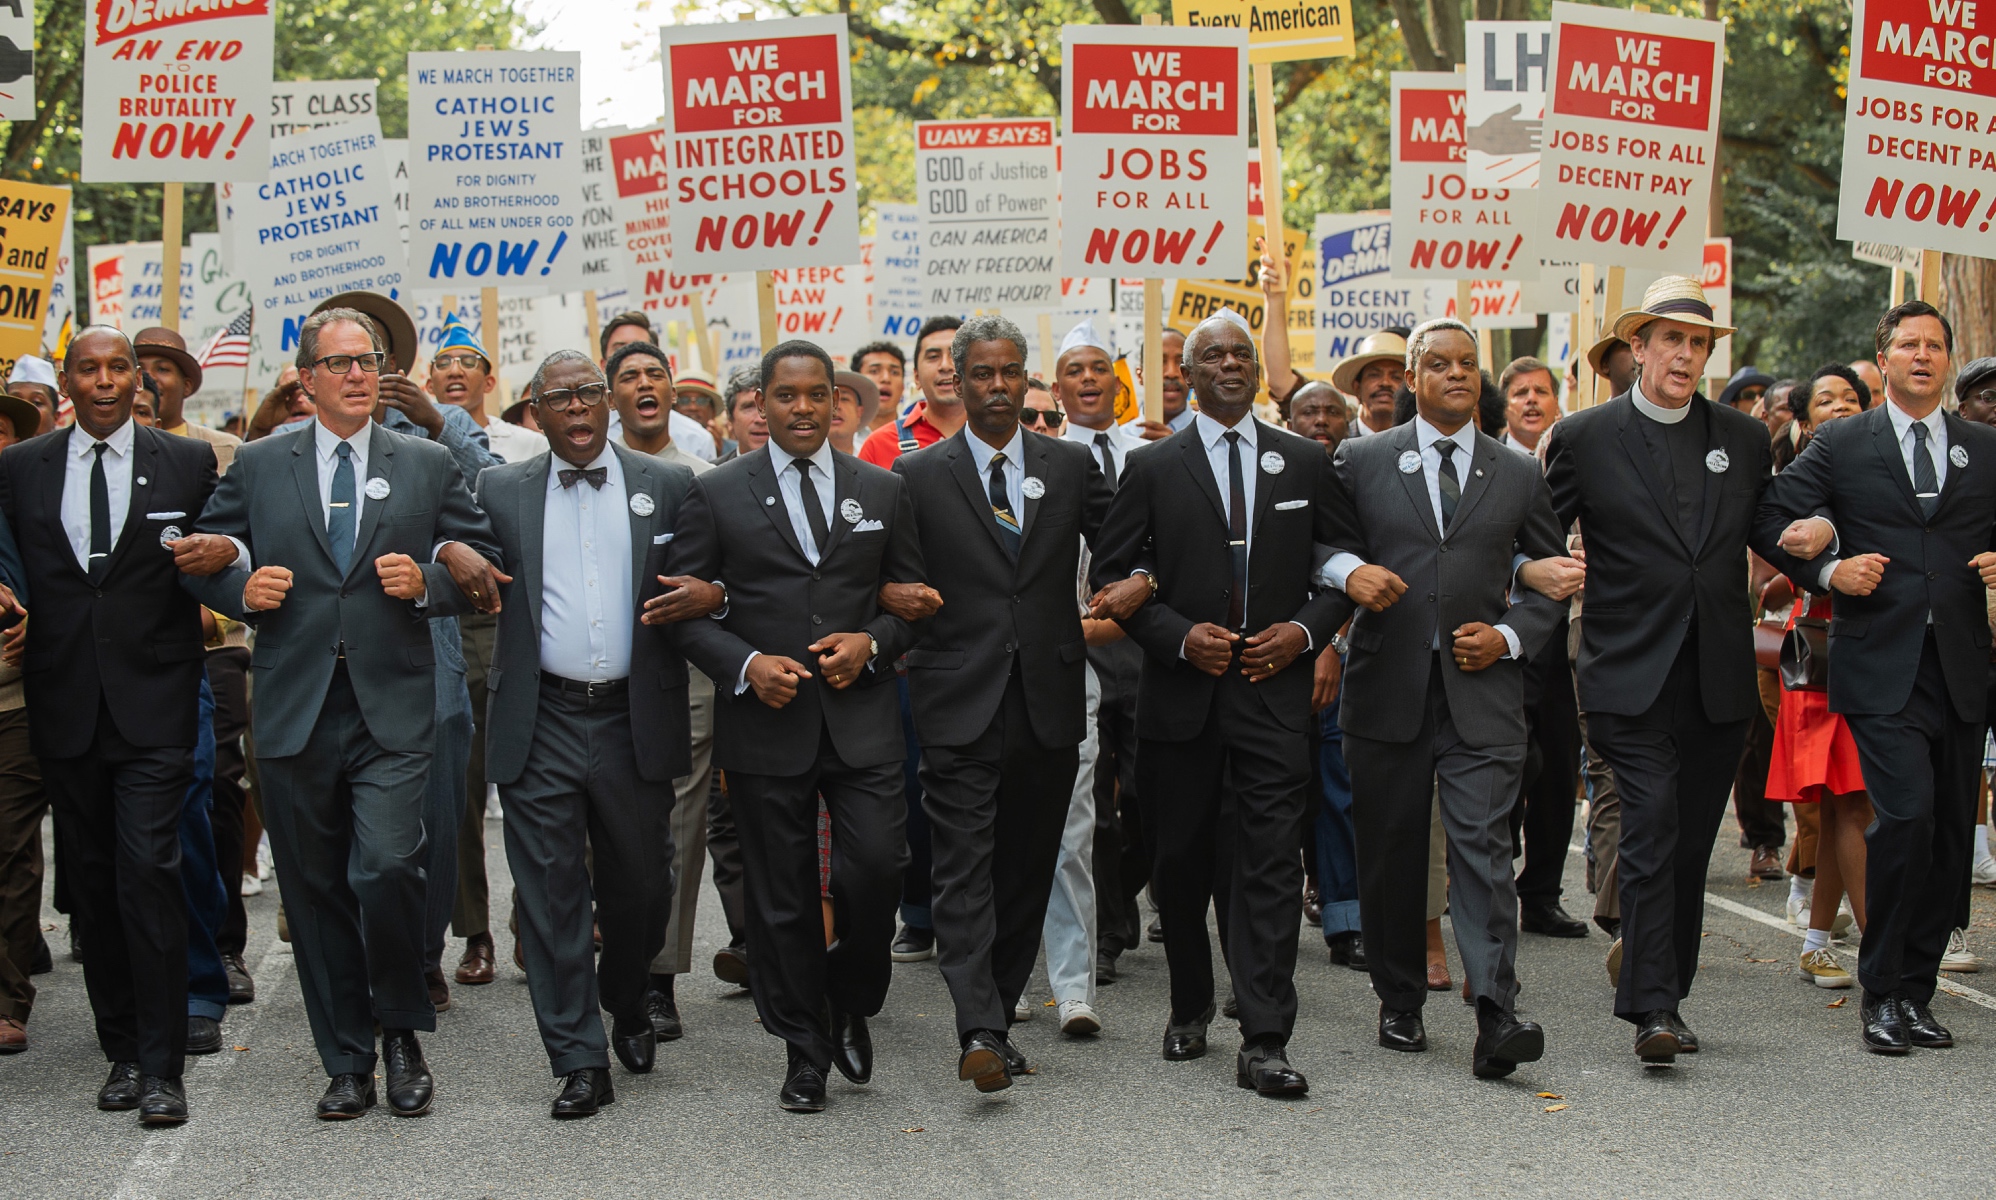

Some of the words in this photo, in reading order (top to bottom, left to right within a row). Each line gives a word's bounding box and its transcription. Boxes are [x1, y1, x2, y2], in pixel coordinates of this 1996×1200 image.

[1250, 2, 1340, 32] American
[1927, 0, 1977, 30] WE
[112, 39, 163, 60] AN
[176, 40, 243, 61] END
[728, 44, 779, 72] WE
[1615, 36, 1662, 67] WE
[1875, 21, 1996, 70] MARC
[163, 64, 190, 72] TO
[418, 70, 437, 84] WE
[443, 68, 493, 84] MARCH
[500, 68, 574, 83] TOGETHER
[1132, 52, 1181, 77] WE
[1924, 65, 1973, 89] FOR
[140, 74, 217, 93] POLICE
[685, 70, 826, 108] MARCH
[1568, 60, 1700, 105] MARCH
[119, 98, 236, 117] BRUTALITY
[308, 93, 372, 115] CLASS
[436, 97, 555, 115] CATHOLIC
[1085, 80, 1224, 111] MARCH
[733, 106, 783, 125] FOR
[1132, 114, 1181, 131] FOR
[1610, 99, 1656, 121] FOR
[1856, 96, 1923, 124] JOBS
[1932, 106, 1979, 133] FOR
[112, 114, 254, 159] NOW!
[460, 120, 530, 138] JEWS
[925, 128, 981, 146] UAW
[986, 126, 1047, 145] SAYS:
[270, 149, 305, 170] ARCH
[310, 134, 376, 161] TOGETHER
[427, 142, 563, 162] PROTESTANT
[675, 130, 844, 169] INTEGRATED
[1549, 130, 1609, 155] JOBS
[1617, 137, 1661, 160] FOR
[1668, 144, 1706, 166] ALL
[1867, 134, 1961, 166] DECENT
[926, 156, 964, 182] GOD
[968, 161, 985, 181] of
[990, 161, 1048, 181] Justice
[1098, 148, 1207, 181] JOBS
[258, 165, 364, 200] CATHOLIC
[457, 175, 481, 187] FOR
[487, 174, 536, 187] DIGNITY
[678, 167, 846, 203] SCHOOLS
[1558, 164, 1645, 192] DECENT
[1651, 173, 1693, 196] PAY
[286, 191, 347, 217] JEWS
[434, 198, 459, 209] AND
[464, 195, 559, 208] BROTHERHOOD
[929, 189, 967, 214] GOD
[976, 194, 991, 213] of
[998, 192, 1047, 212] Power
[1097, 191, 1148, 209] FOR
[1165, 192, 1209, 209] ALL
[258, 205, 380, 245] PROTESTANT
[420, 219, 436, 230] OF
[441, 219, 463, 230] ALL
[469, 218, 496, 229] MEN
[501, 217, 542, 228] UNDER
[547, 216, 573, 227] GOD
[695, 199, 834, 253] NOW!
[1420, 209, 1462, 225] FOR
[1475, 209, 1511, 225] ALL
[1555, 202, 1687, 250] NOW!
[929, 230, 967, 248] CAN
[972, 227, 1048, 246] AMERICA
[1084, 220, 1224, 265] NOW!
[1351, 225, 1390, 251] WE
[8, 246, 50, 271] and
[290, 250, 313, 263] FOR
[316, 239, 361, 259] DIGNITY
[428, 231, 568, 279] NOW!
[636, 252, 660, 265] ALL
[1410, 233, 1523, 271] NOW!
[274, 273, 297, 288] AND
[300, 256, 385, 282] BROTHERHOOD
[797, 267, 845, 284] FEPC
[927, 259, 970, 276] DENY
[975, 256, 1053, 274] FREEDOM
[264, 296, 279, 309] OF
[284, 291, 305, 305] ALL
[309, 284, 333, 300] MEN
[336, 278, 374, 297] UNDER
[377, 272, 402, 288] GOD
[778, 288, 825, 305] LAW
[931, 287, 951, 304] IN
[955, 286, 992, 303] THIS
[997, 284, 1051, 301] HOUR?
[1331, 290, 1411, 307] DECENT
[1322, 312, 1416, 329] HOUSING
